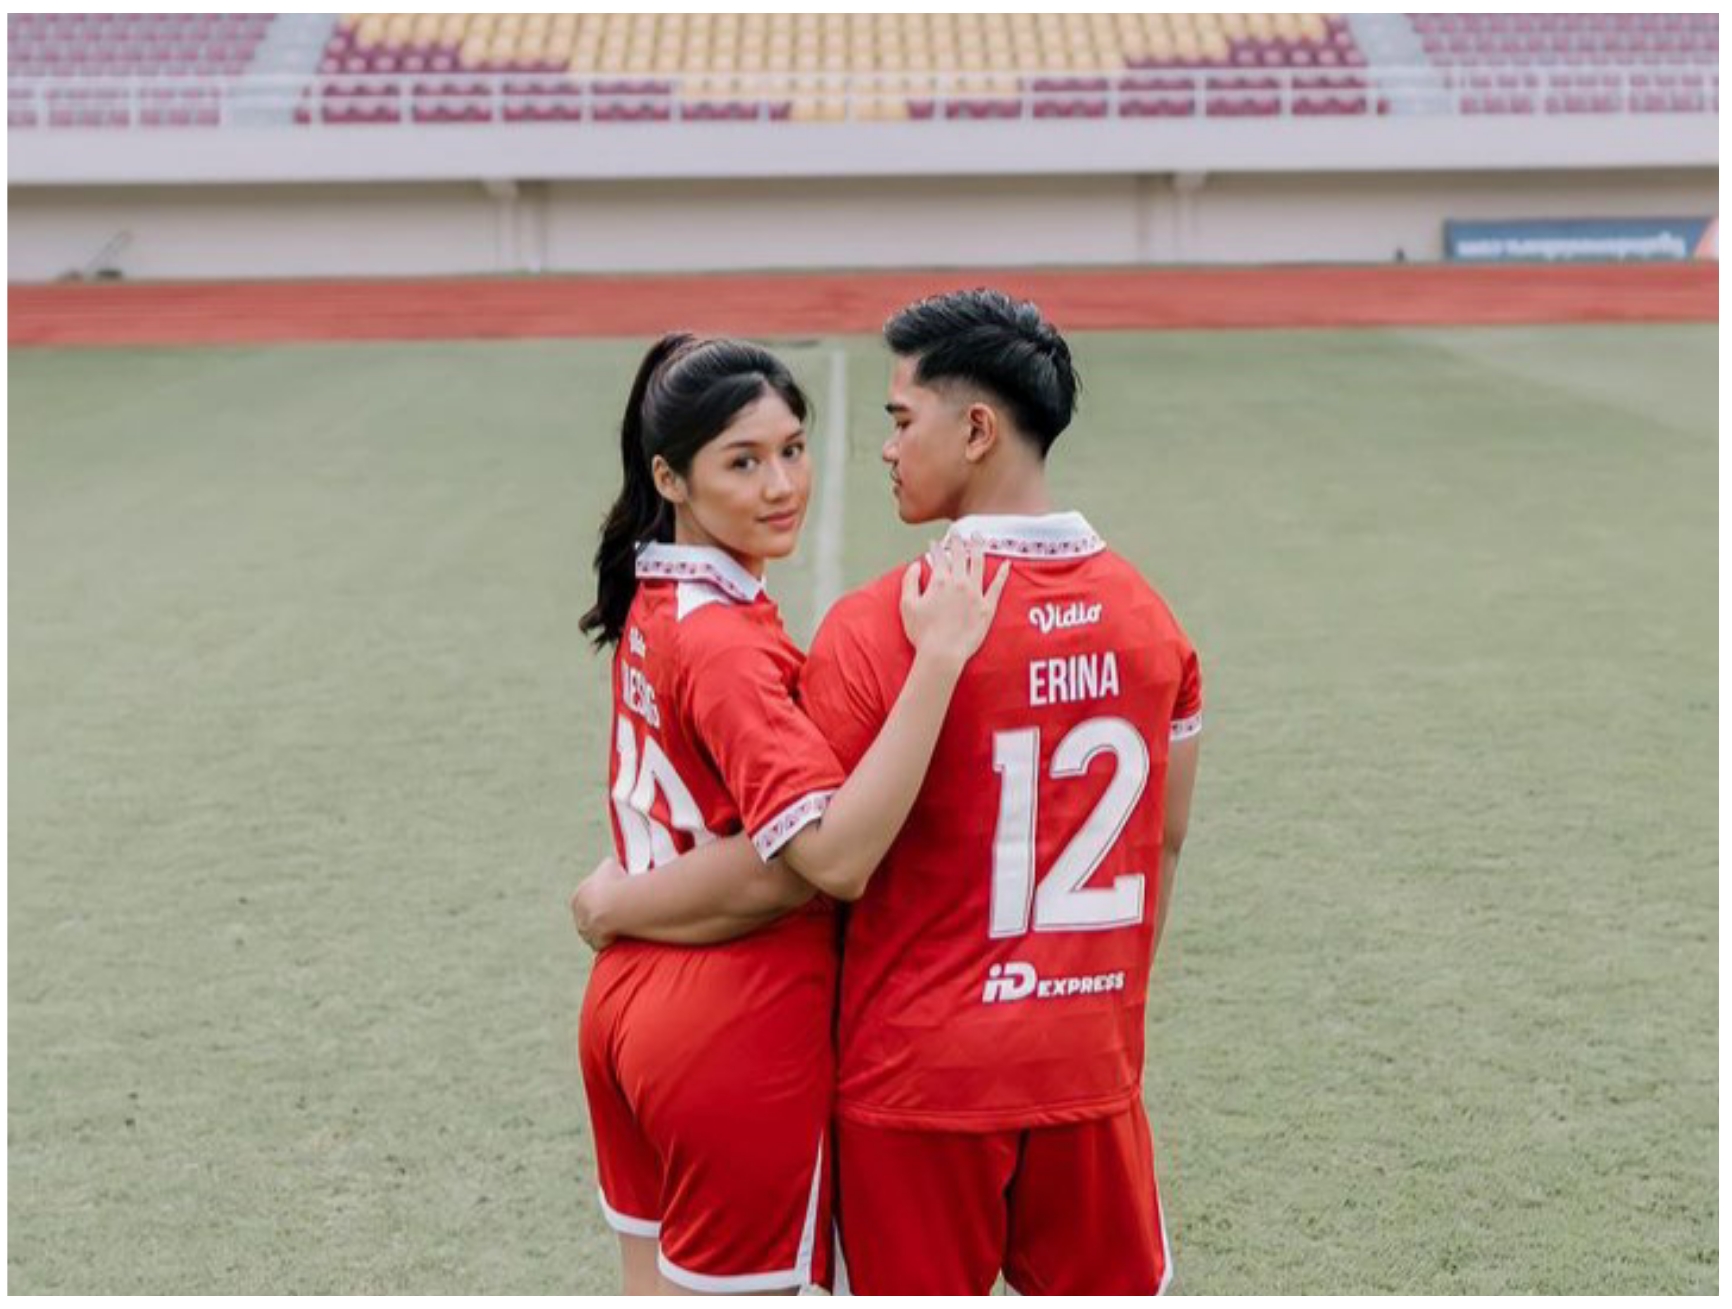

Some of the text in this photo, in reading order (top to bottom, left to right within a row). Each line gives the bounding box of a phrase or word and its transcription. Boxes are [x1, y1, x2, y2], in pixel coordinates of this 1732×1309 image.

[1028, 601, 1103, 635] Vidio
[1029, 650, 1121, 707] ERINA
[988, 715, 1151, 940] 12
[1036, 971, 1125, 998] EXPRESS
